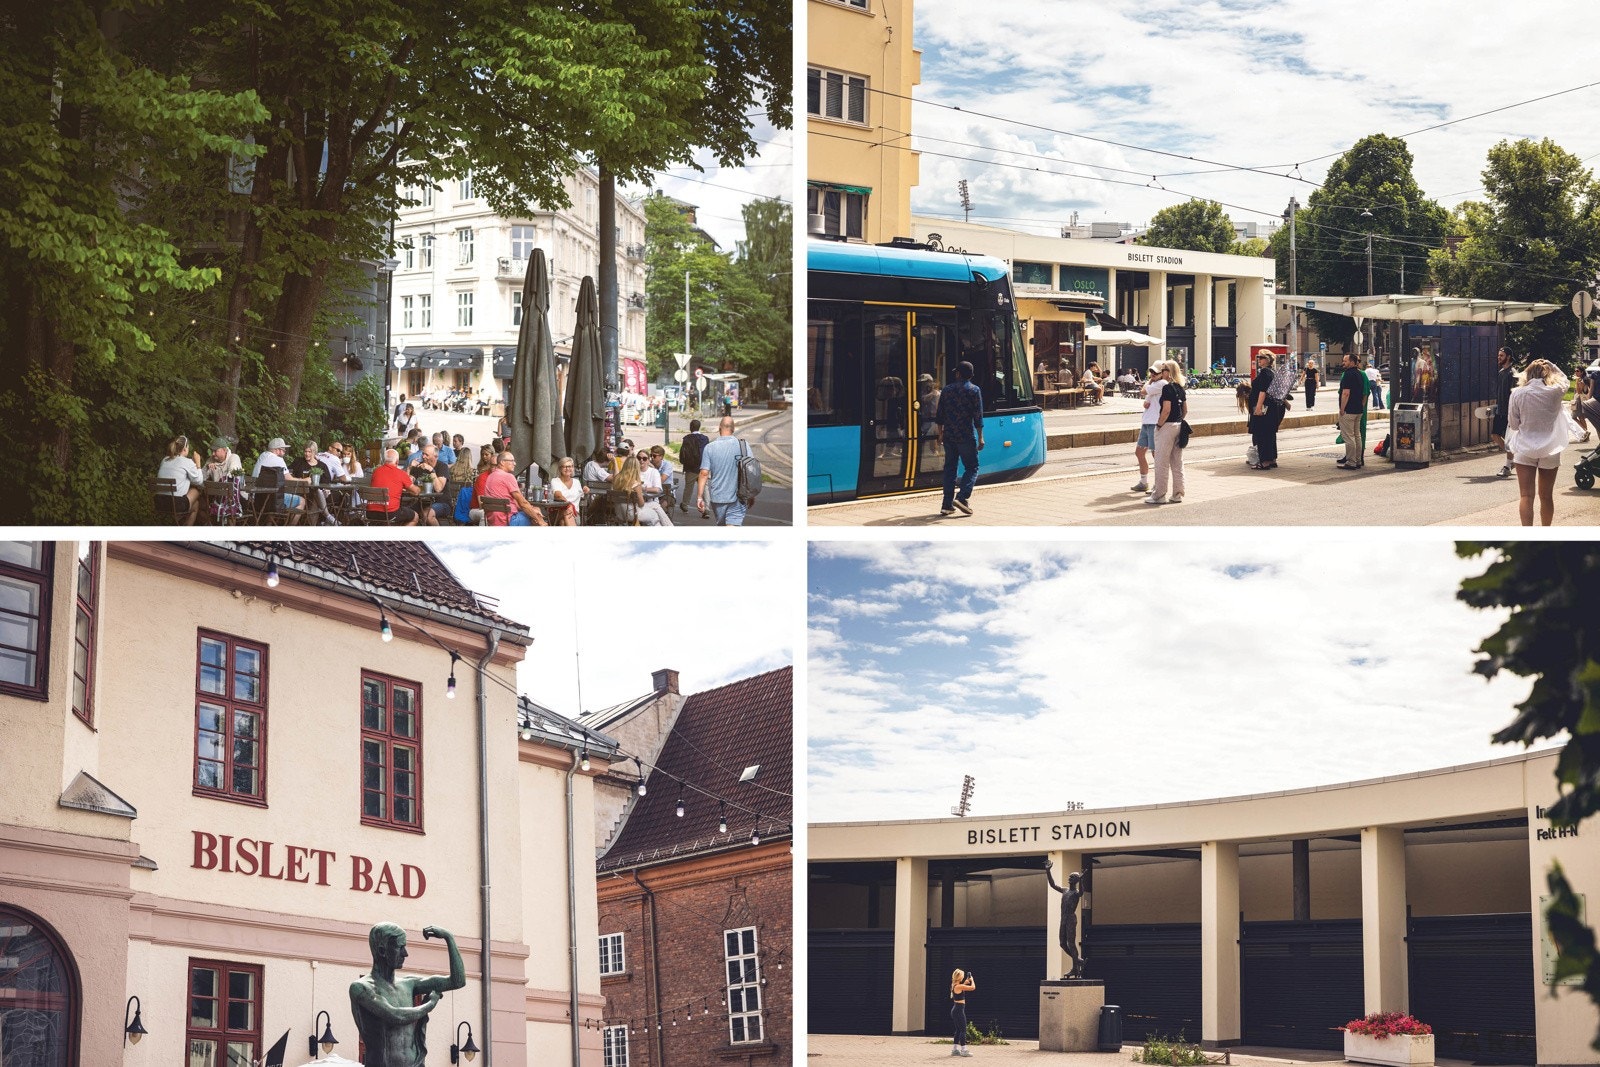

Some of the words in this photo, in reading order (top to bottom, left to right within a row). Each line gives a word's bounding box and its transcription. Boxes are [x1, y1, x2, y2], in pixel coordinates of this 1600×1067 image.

[1128, 253, 1153, 262] BISLETT
[1157, 255, 1182, 265] STADION
[1074, 280, 1095, 289] OSLO
[968, 826, 1041, 844] BISLETT
[1051, 821, 1131, 840] STADION
[1537, 828, 1557, 841] Felt
[1558, 825, 1578, 838] H-N
[190, 830, 336, 886] BISLET
[349, 855, 427, 899] BAD
